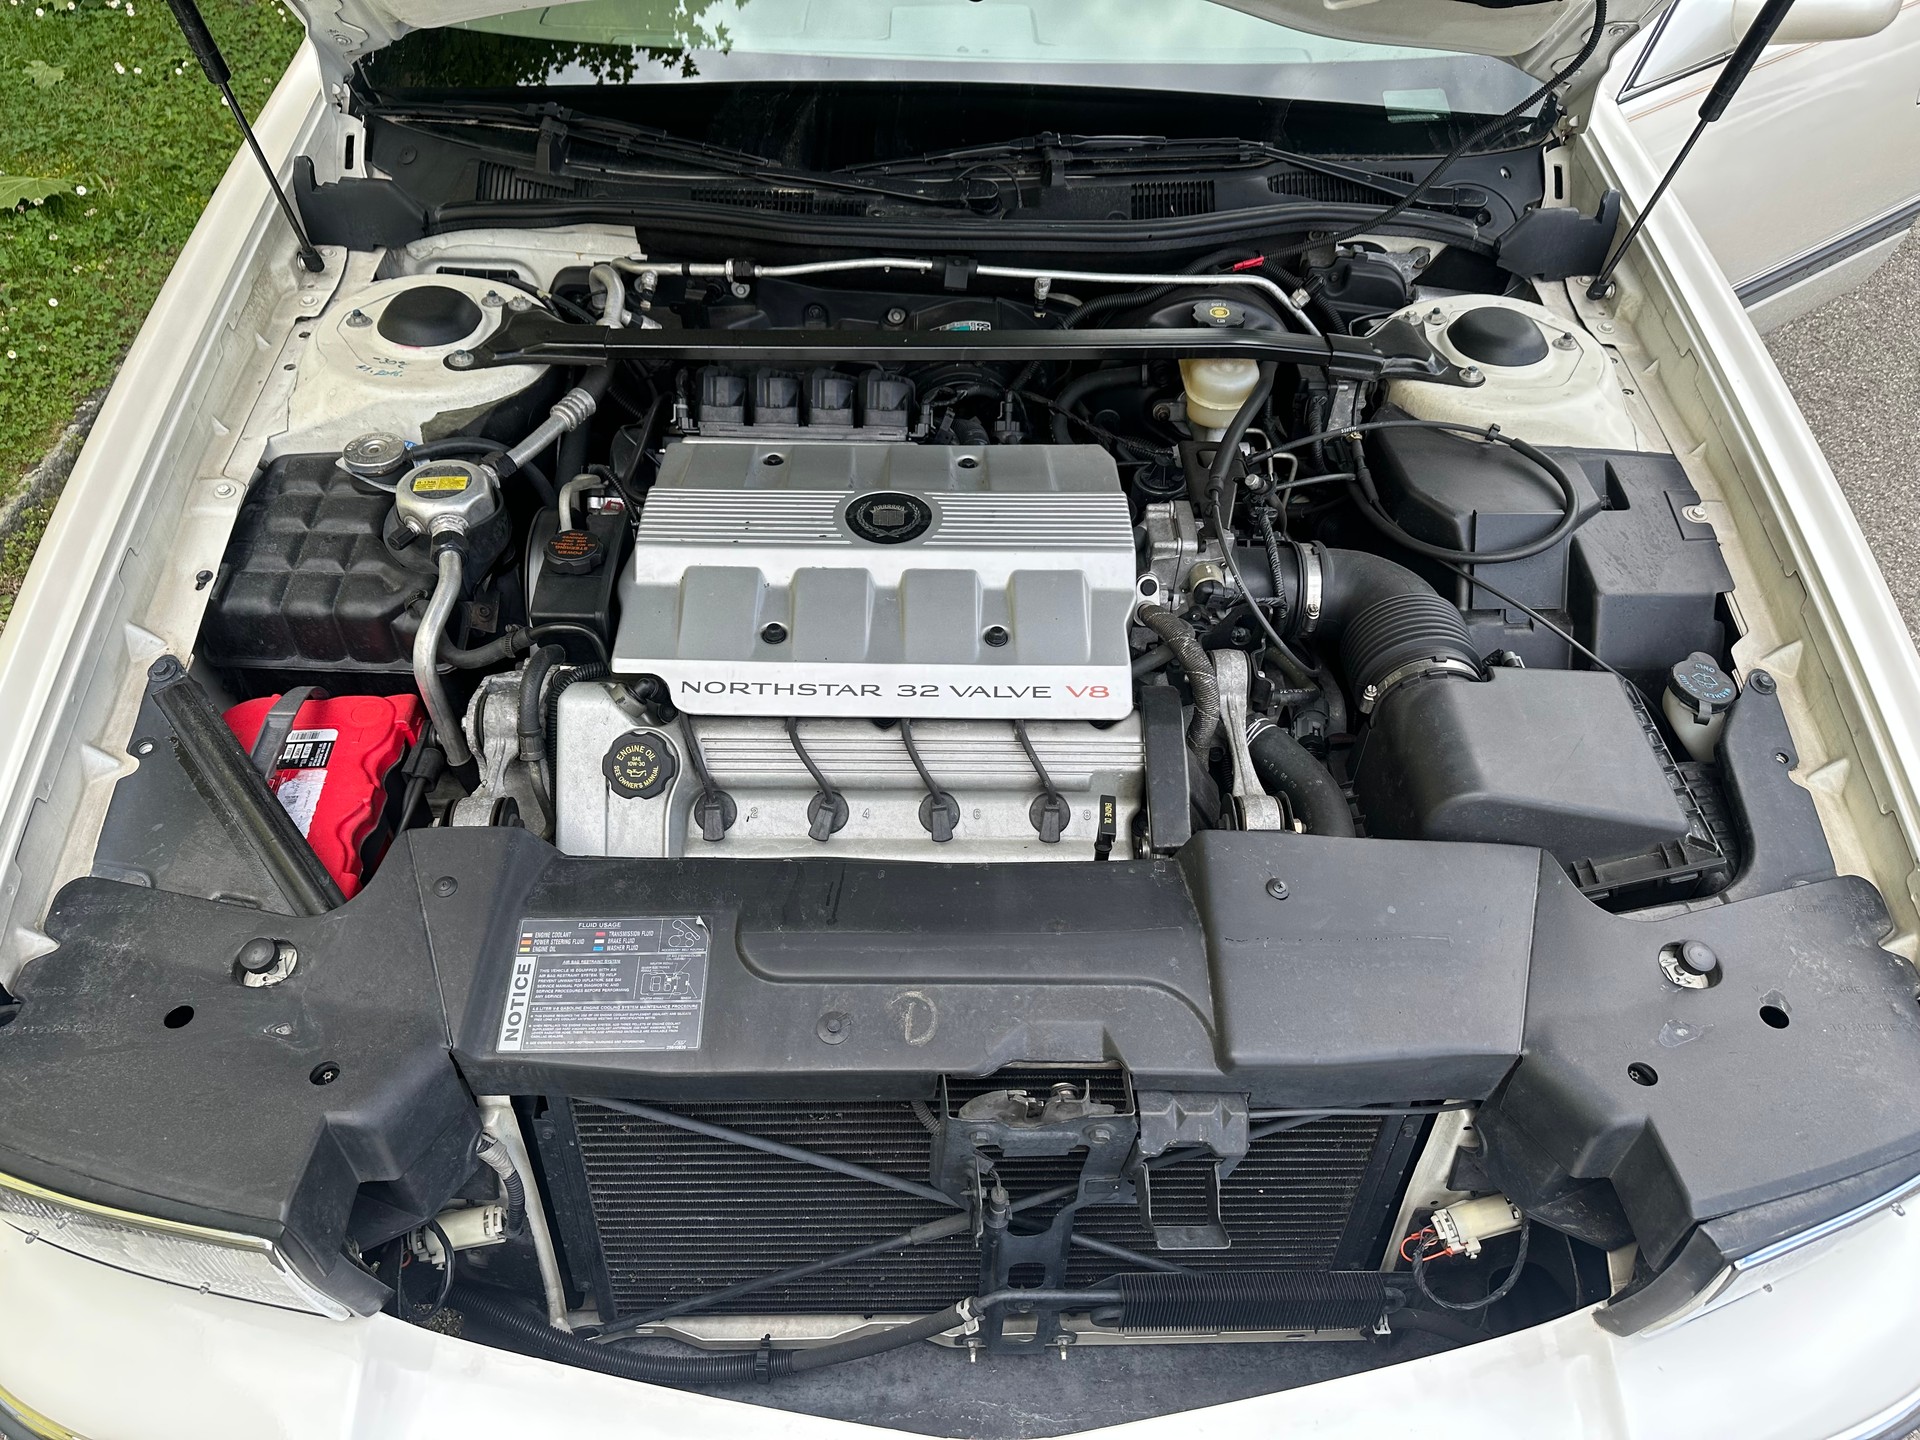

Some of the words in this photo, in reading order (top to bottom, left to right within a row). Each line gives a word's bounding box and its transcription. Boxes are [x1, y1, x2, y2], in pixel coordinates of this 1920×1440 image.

[1695, 663, 1715, 673] ONLY
[681, 681, 882, 697] NORTHSTAR
[897, 684, 939, 697] 32
[949, 685, 1051, 698] VALVE
[1066, 686, 1110, 698] V8
[616, 745, 645, 761] ENGINE
[645, 750, 656, 762] OIL
[619, 777, 643, 788] OWNER'S
[643, 766, 659, 786] MANUAL
[504, 964, 532, 1042] NOTICE
